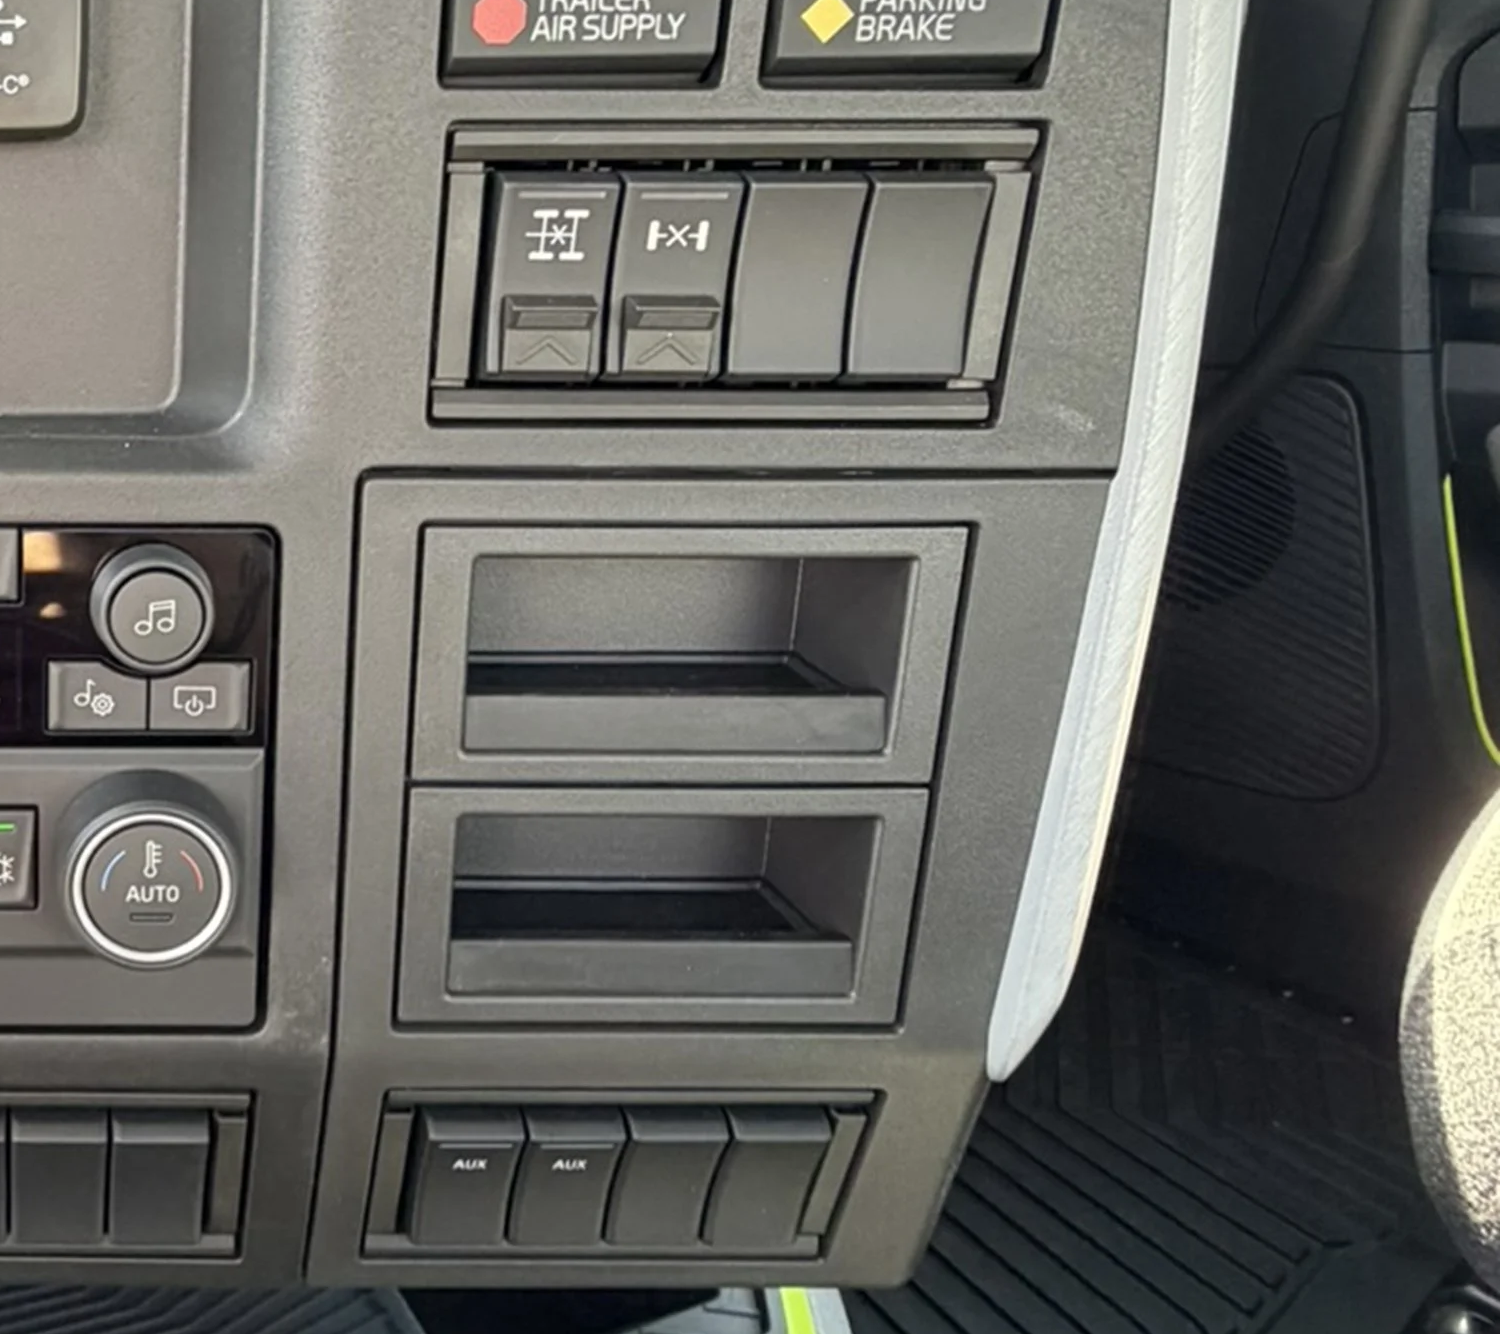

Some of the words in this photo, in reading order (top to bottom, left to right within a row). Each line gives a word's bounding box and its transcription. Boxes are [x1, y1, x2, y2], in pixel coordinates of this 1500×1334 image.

[529, 14, 577, 42] AIR
[581, 12, 687, 42] SUPPLY
[854, 14, 956, 42] BRAKE
[125, 884, 180, 904] AUTO
[452, 1158, 488, 1171] AUX
[551, 1158, 588, 1171] AUX
